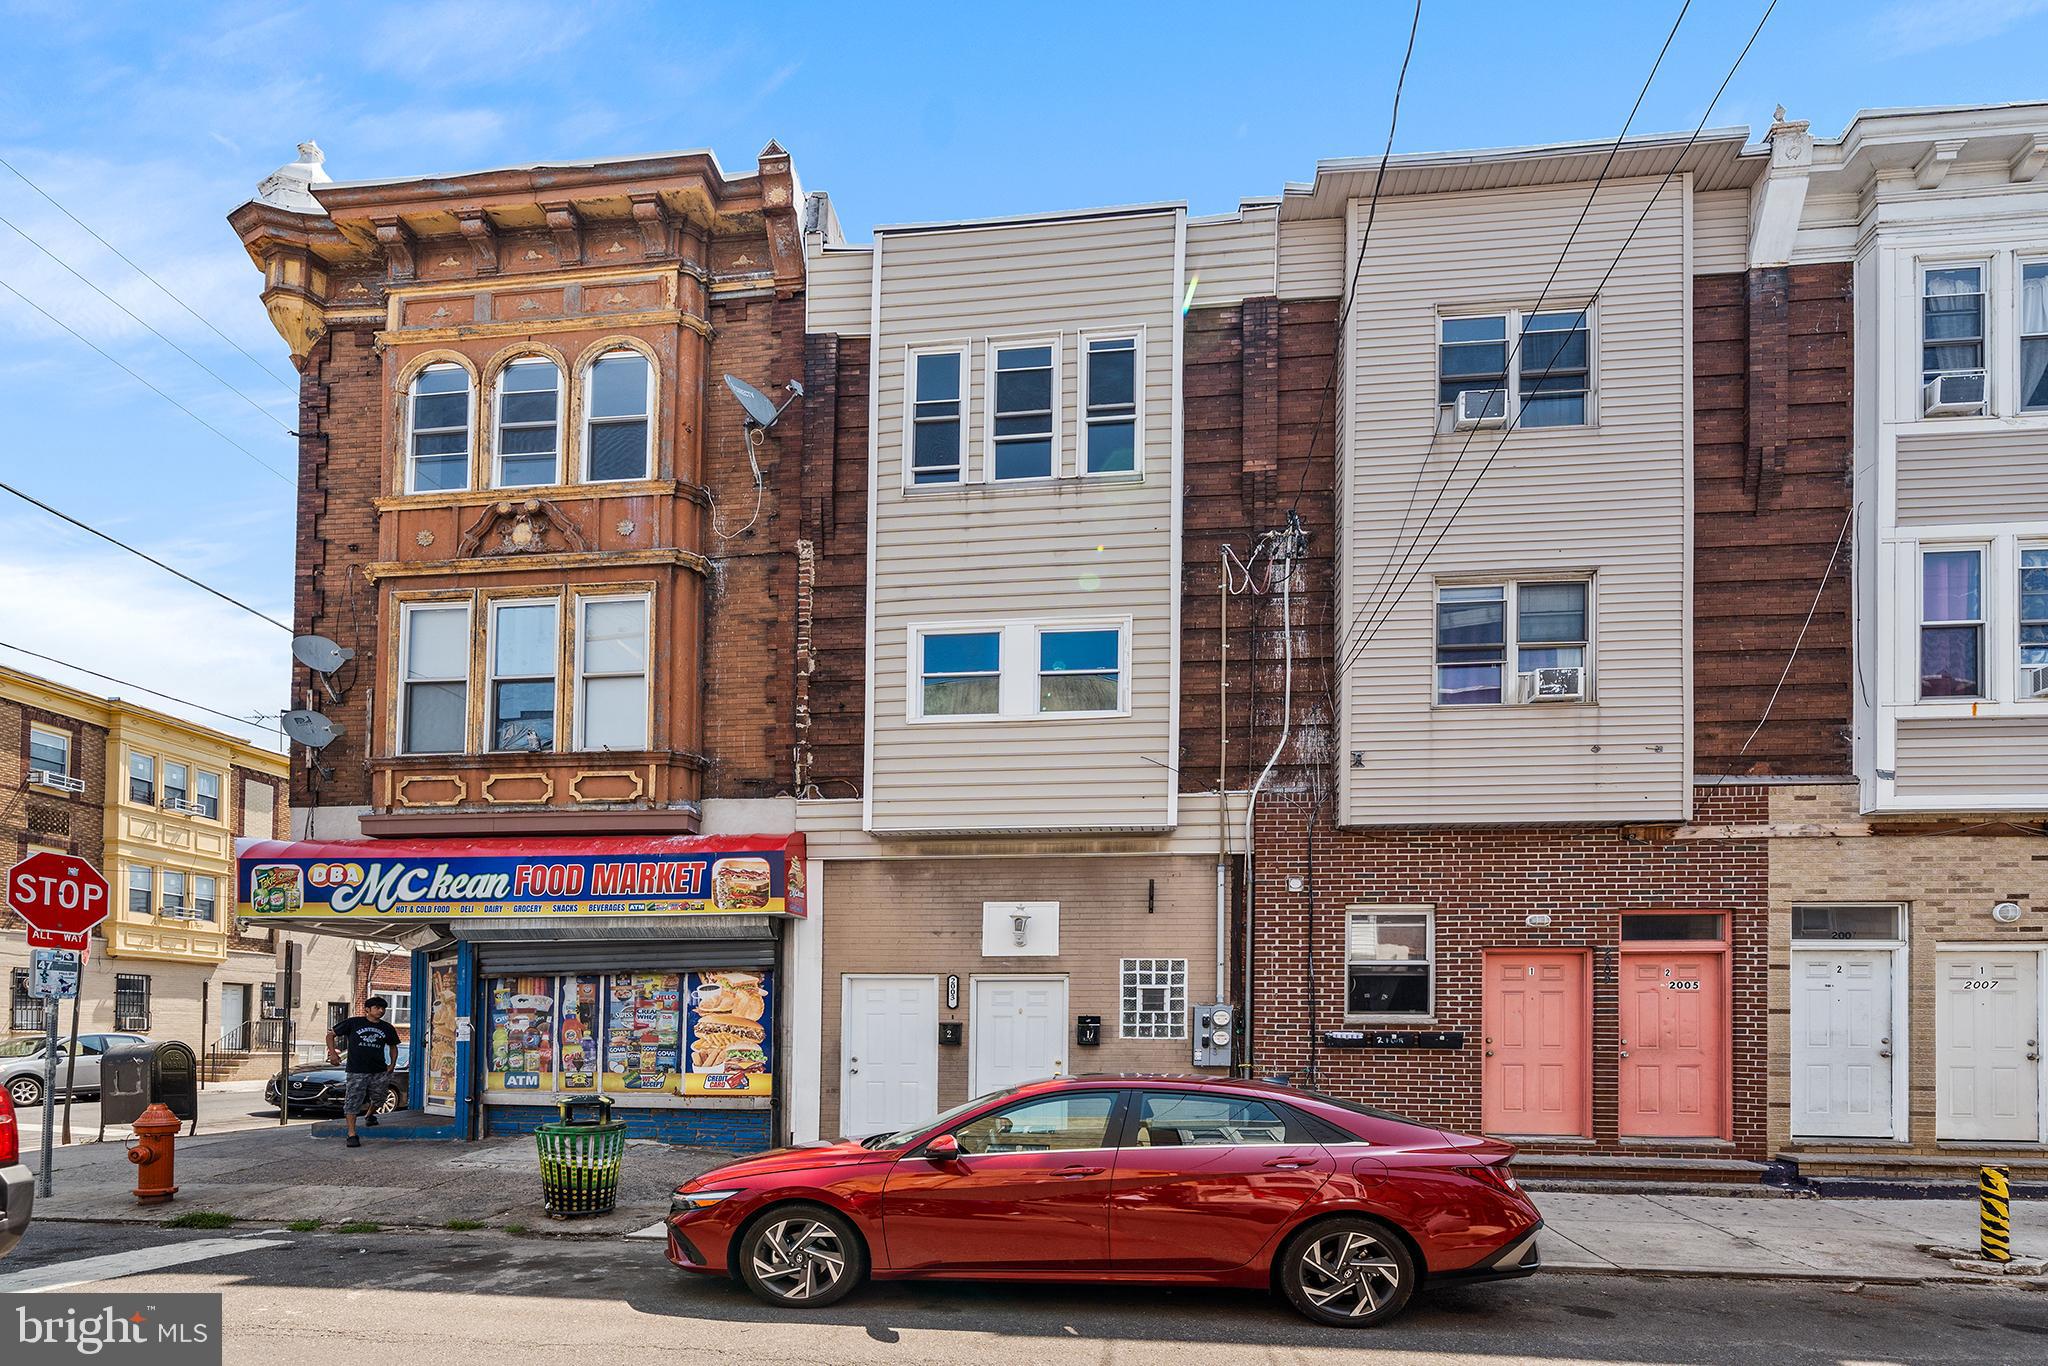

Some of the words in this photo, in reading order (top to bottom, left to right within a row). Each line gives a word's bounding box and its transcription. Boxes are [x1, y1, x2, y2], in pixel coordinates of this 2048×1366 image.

[312, 868, 359, 883] DBA
[513, 863, 585, 897] FOOD
[590, 861, 707, 896] MARKET
[15, 873, 104, 911] STOP
[395, 905, 408, 913] HOT
[409, 905, 415, 913] &
[416, 905, 432, 913] COLD
[433, 905, 450, 913] FOOD
[460, 905, 474, 913] DELI
[484, 905, 503, 913] DAIRY
[513, 904, 542, 913] GROCERY
[552, 904, 578, 912] SNACKS
[588, 903, 625, 912] BEVERAGES
[32, 931, 53, 941] ALL
[63, 934, 84, 943] WAY
[37, 960, 52, 970] 47
[1836, 965, 1842, 974] 2
[1665, 968, 1670, 977] 2
[1669, 981, 1699, 990] 2005
[1963, 980, 1999, 990] 2007
[946, 1030, 952, 1038] 2
[506, 1075, 538, 1086] ATM
